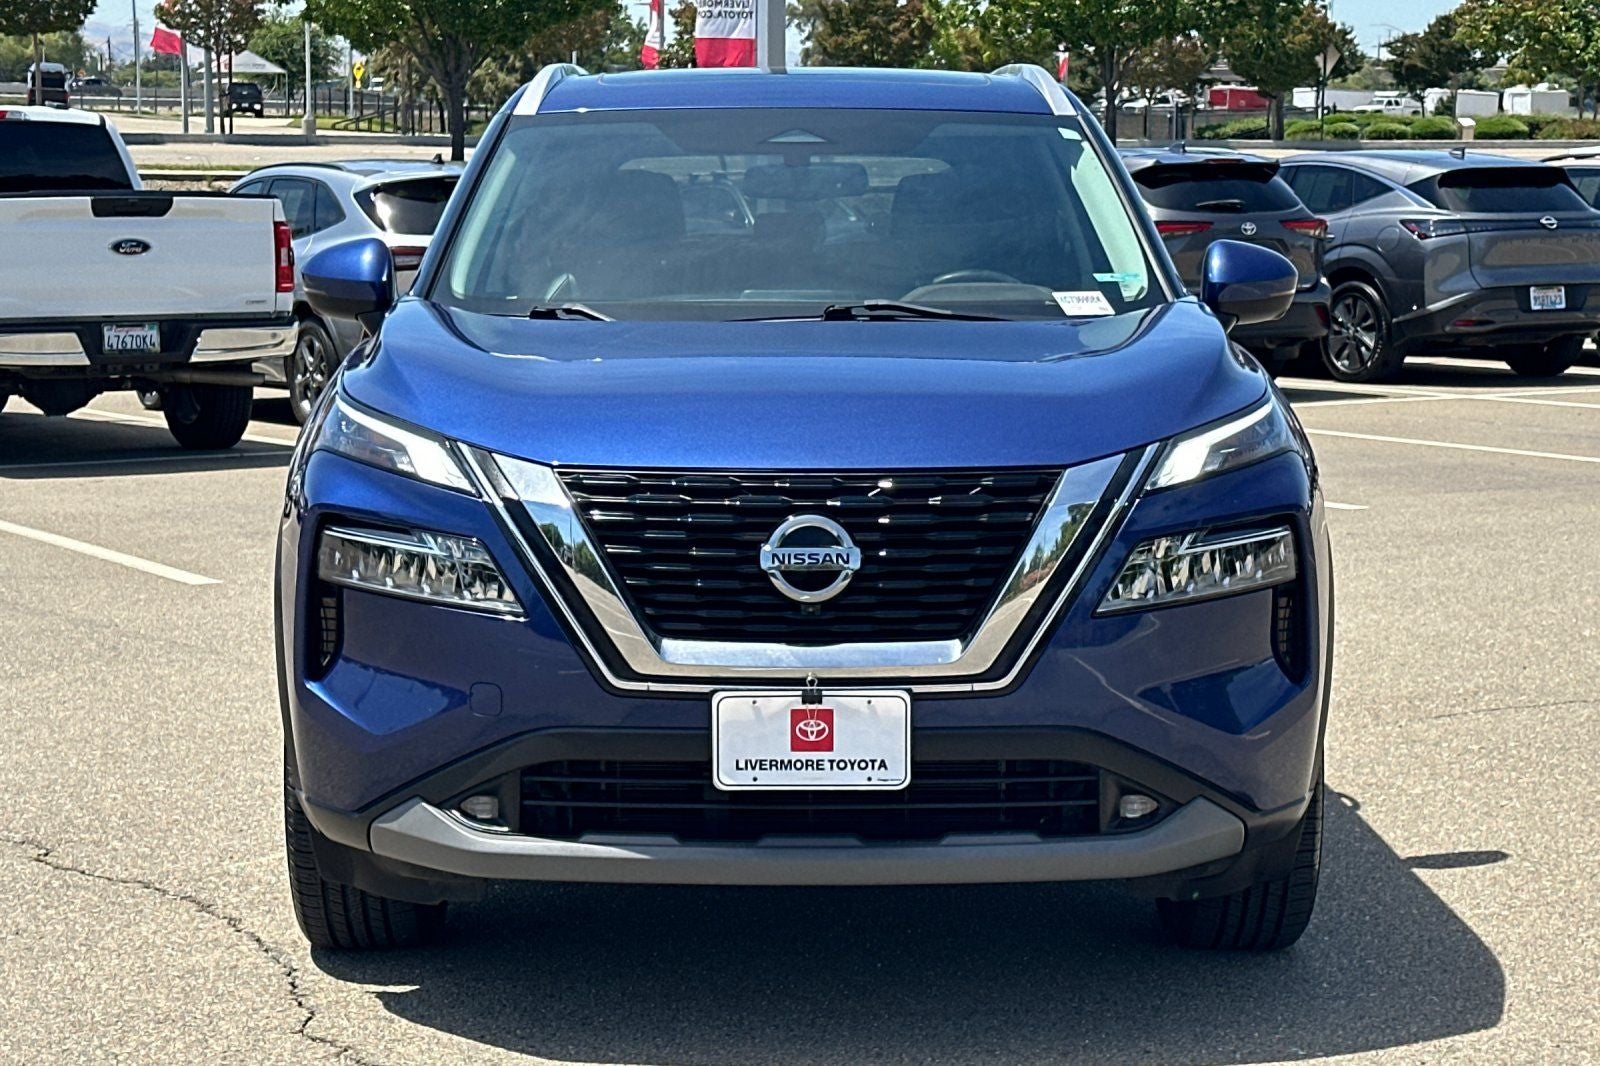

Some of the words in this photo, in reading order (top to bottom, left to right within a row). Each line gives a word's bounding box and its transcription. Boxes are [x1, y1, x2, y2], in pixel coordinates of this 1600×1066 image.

[106, 334, 156, 349] 47670K4
[771, 552, 850, 565] NISSAN
[735, 759, 825, 771] LIVERMORE
[828, 759, 888, 771] TOYOTA
